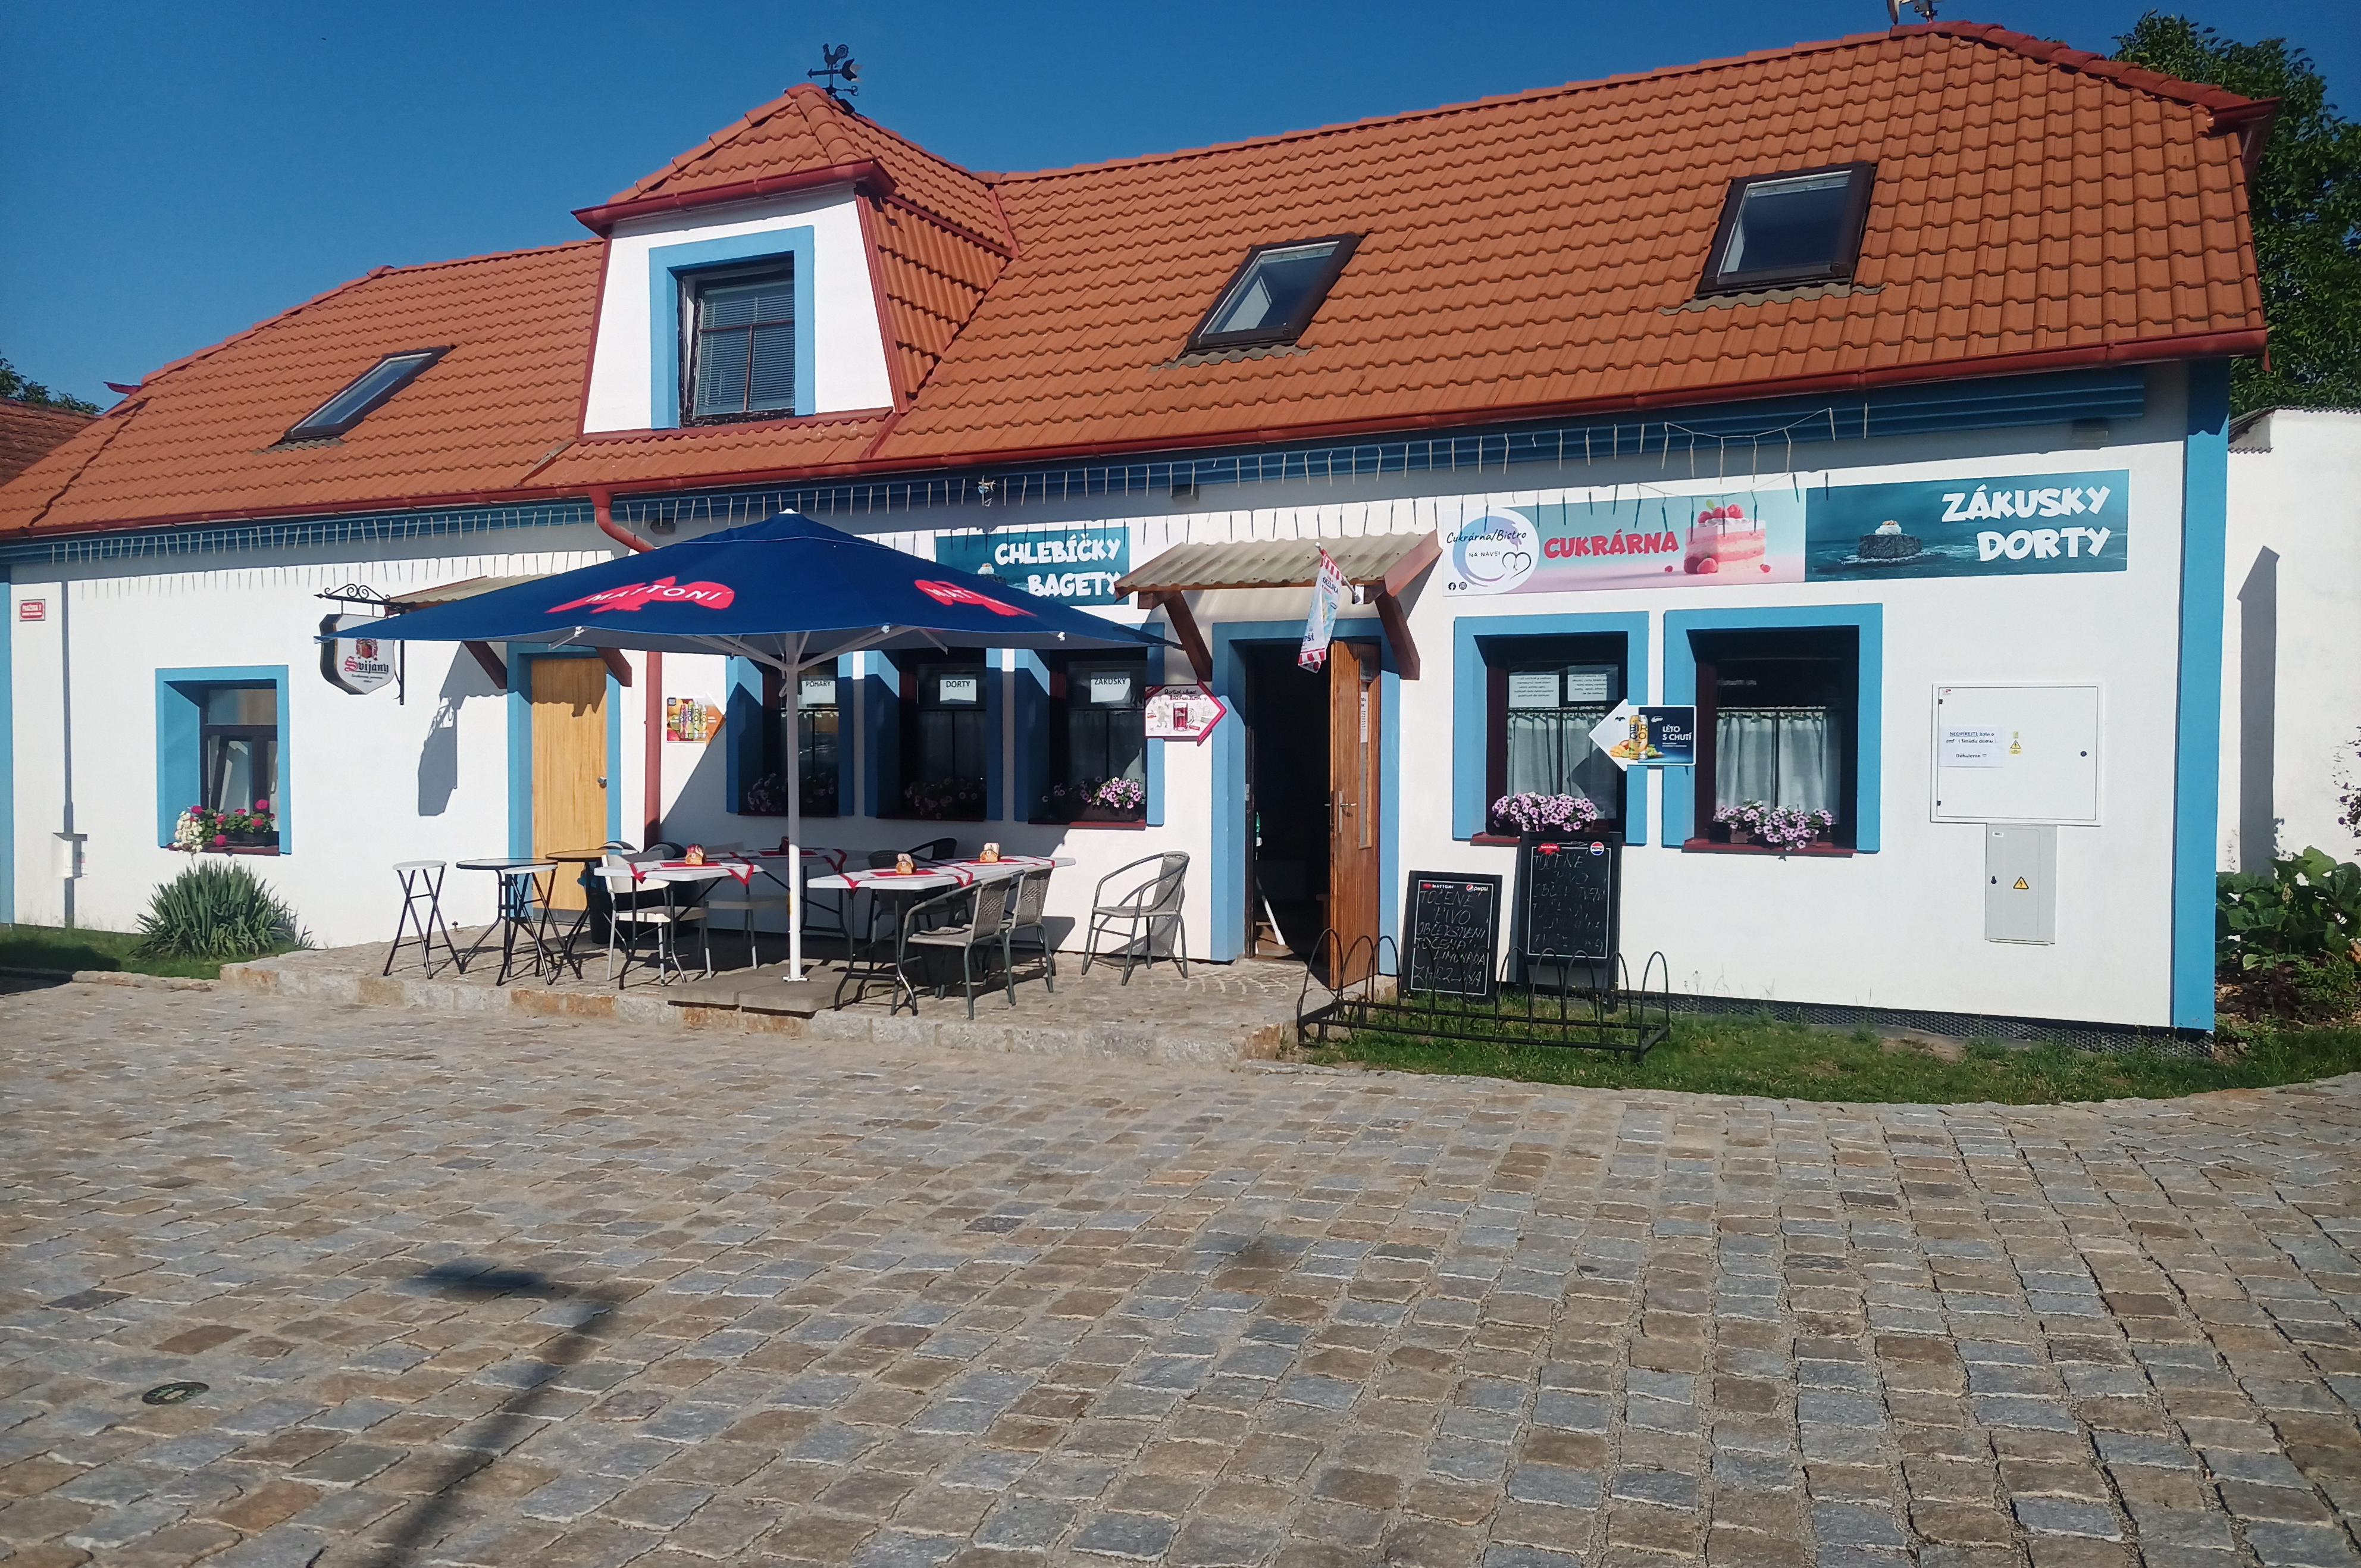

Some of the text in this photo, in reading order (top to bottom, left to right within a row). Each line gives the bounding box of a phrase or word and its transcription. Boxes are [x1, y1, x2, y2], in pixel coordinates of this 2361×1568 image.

[1942, 484, 2111, 522] ZÁKUSKY
[994, 533, 1121, 565] CHLEBÍČKY
[1544, 528, 1679, 559] CUKRÁRNA
[1977, 527, 2111, 562] DORTY
[585, 584, 723, 602] MATTONI
[1028, 571, 1121, 597] BAGETY
[344, 656, 389, 674] Svijany
[1095, 677, 1126, 685] ZÁKUSKY
[1668, 733, 1692, 741] CHUTÍ
